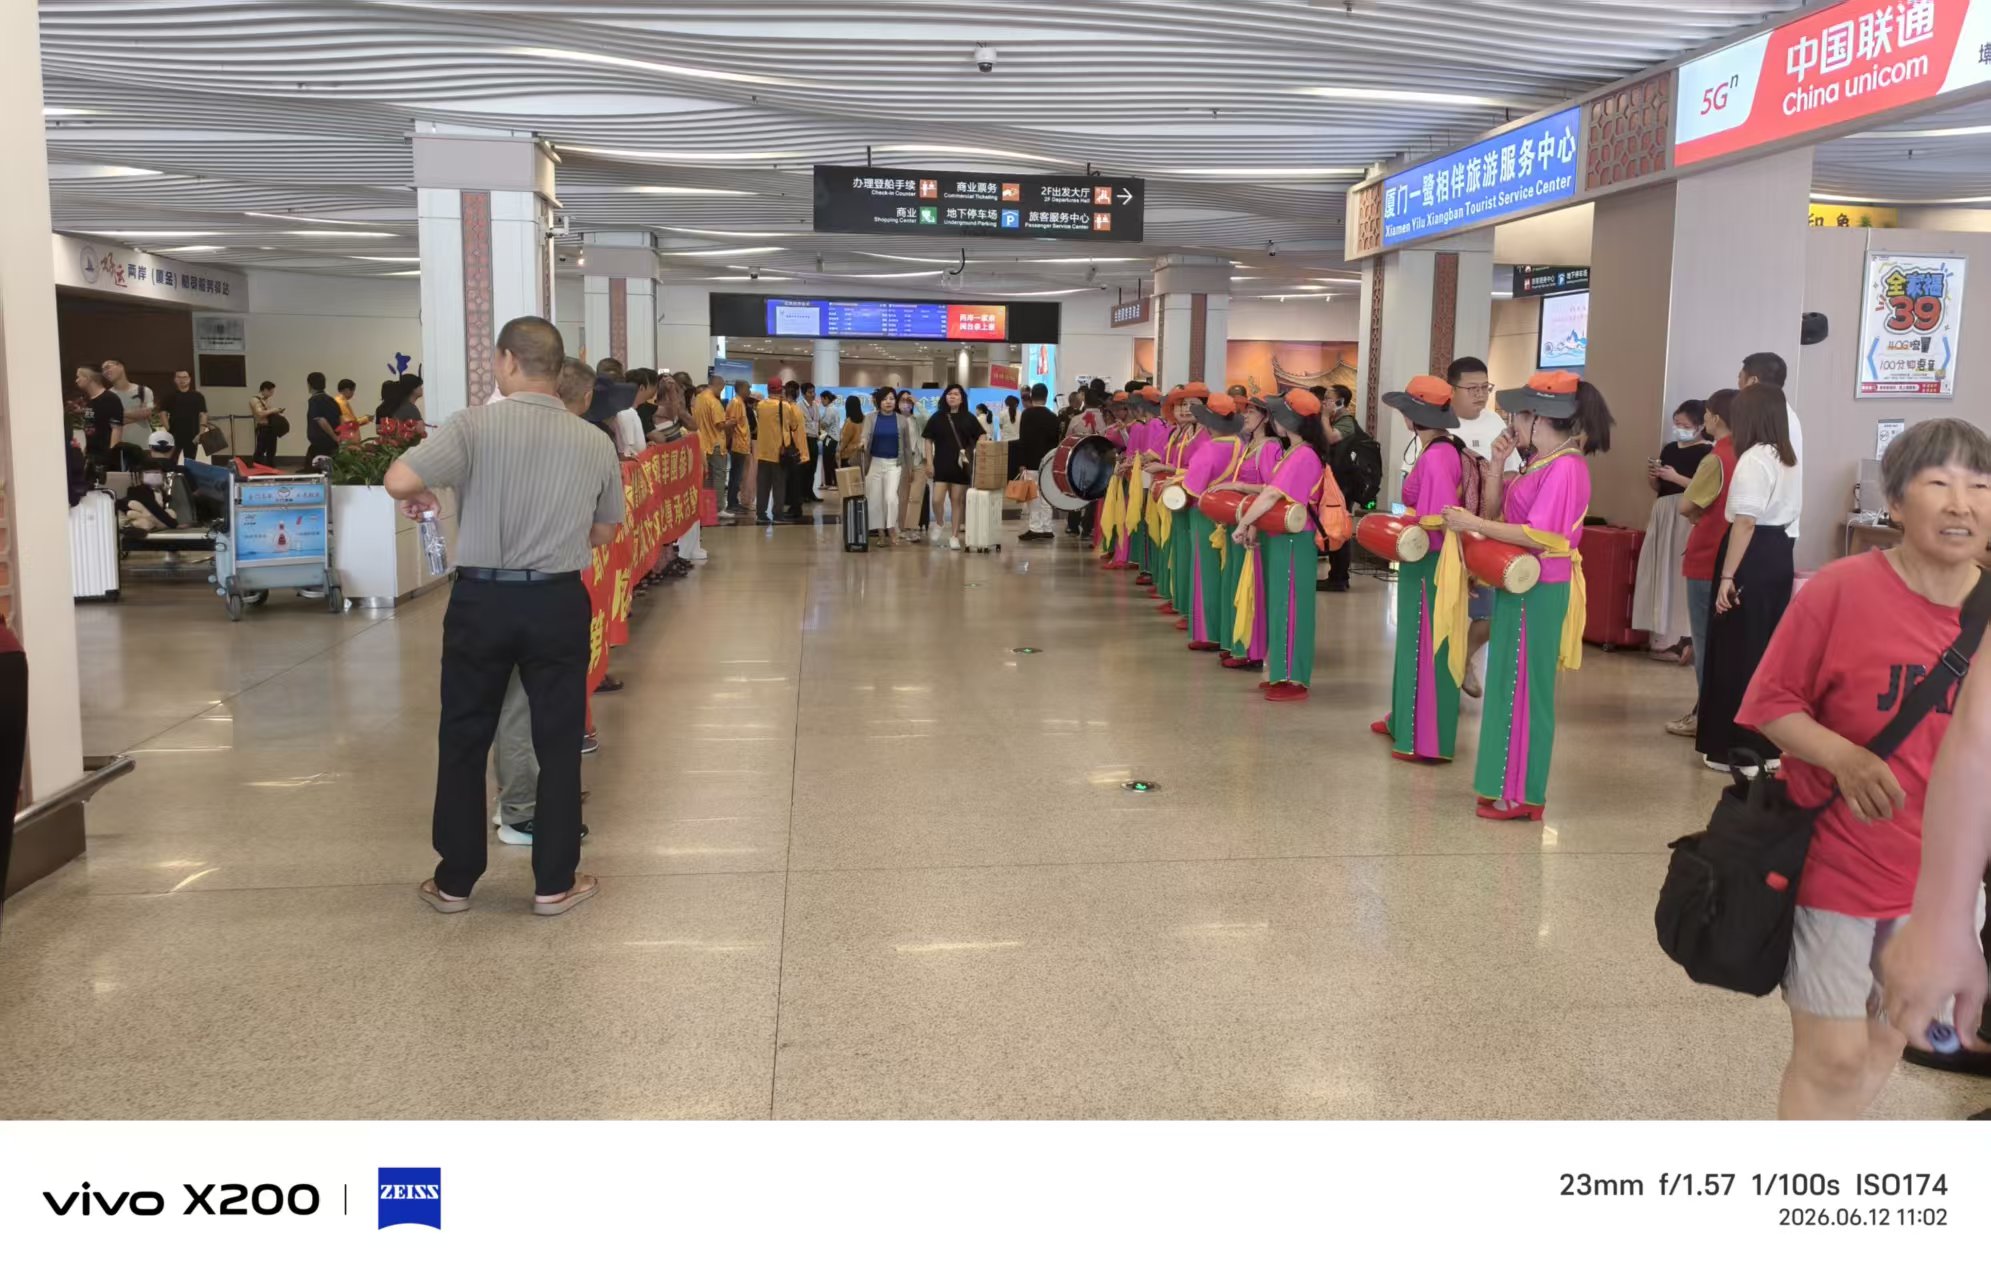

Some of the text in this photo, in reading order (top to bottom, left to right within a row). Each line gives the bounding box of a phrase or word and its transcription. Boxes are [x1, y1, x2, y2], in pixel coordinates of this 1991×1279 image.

[1786, 0, 1934, 83] 中国联通
[1782, 54, 1928, 116] China unicom
[1384, 126, 1576, 219] 厦门一鹭相伴旅游服务中心
[853, 178, 916, 191] 办理登船手续
[957, 182, 997, 193] 商业票务
[1041, 187, 1090, 198] 2F出发大厅
[896, 207, 917, 218] 商业
[1385, 174, 1571, 238] Xiamen Yilu Xiangban Tourist Service Center
[874, 216, 898, 224] Shopping
[946, 208, 997, 220] 地下停车场
[1029, 211, 1090, 224] 旅客服务中心
[1886, 296, 1942, 331] 39
